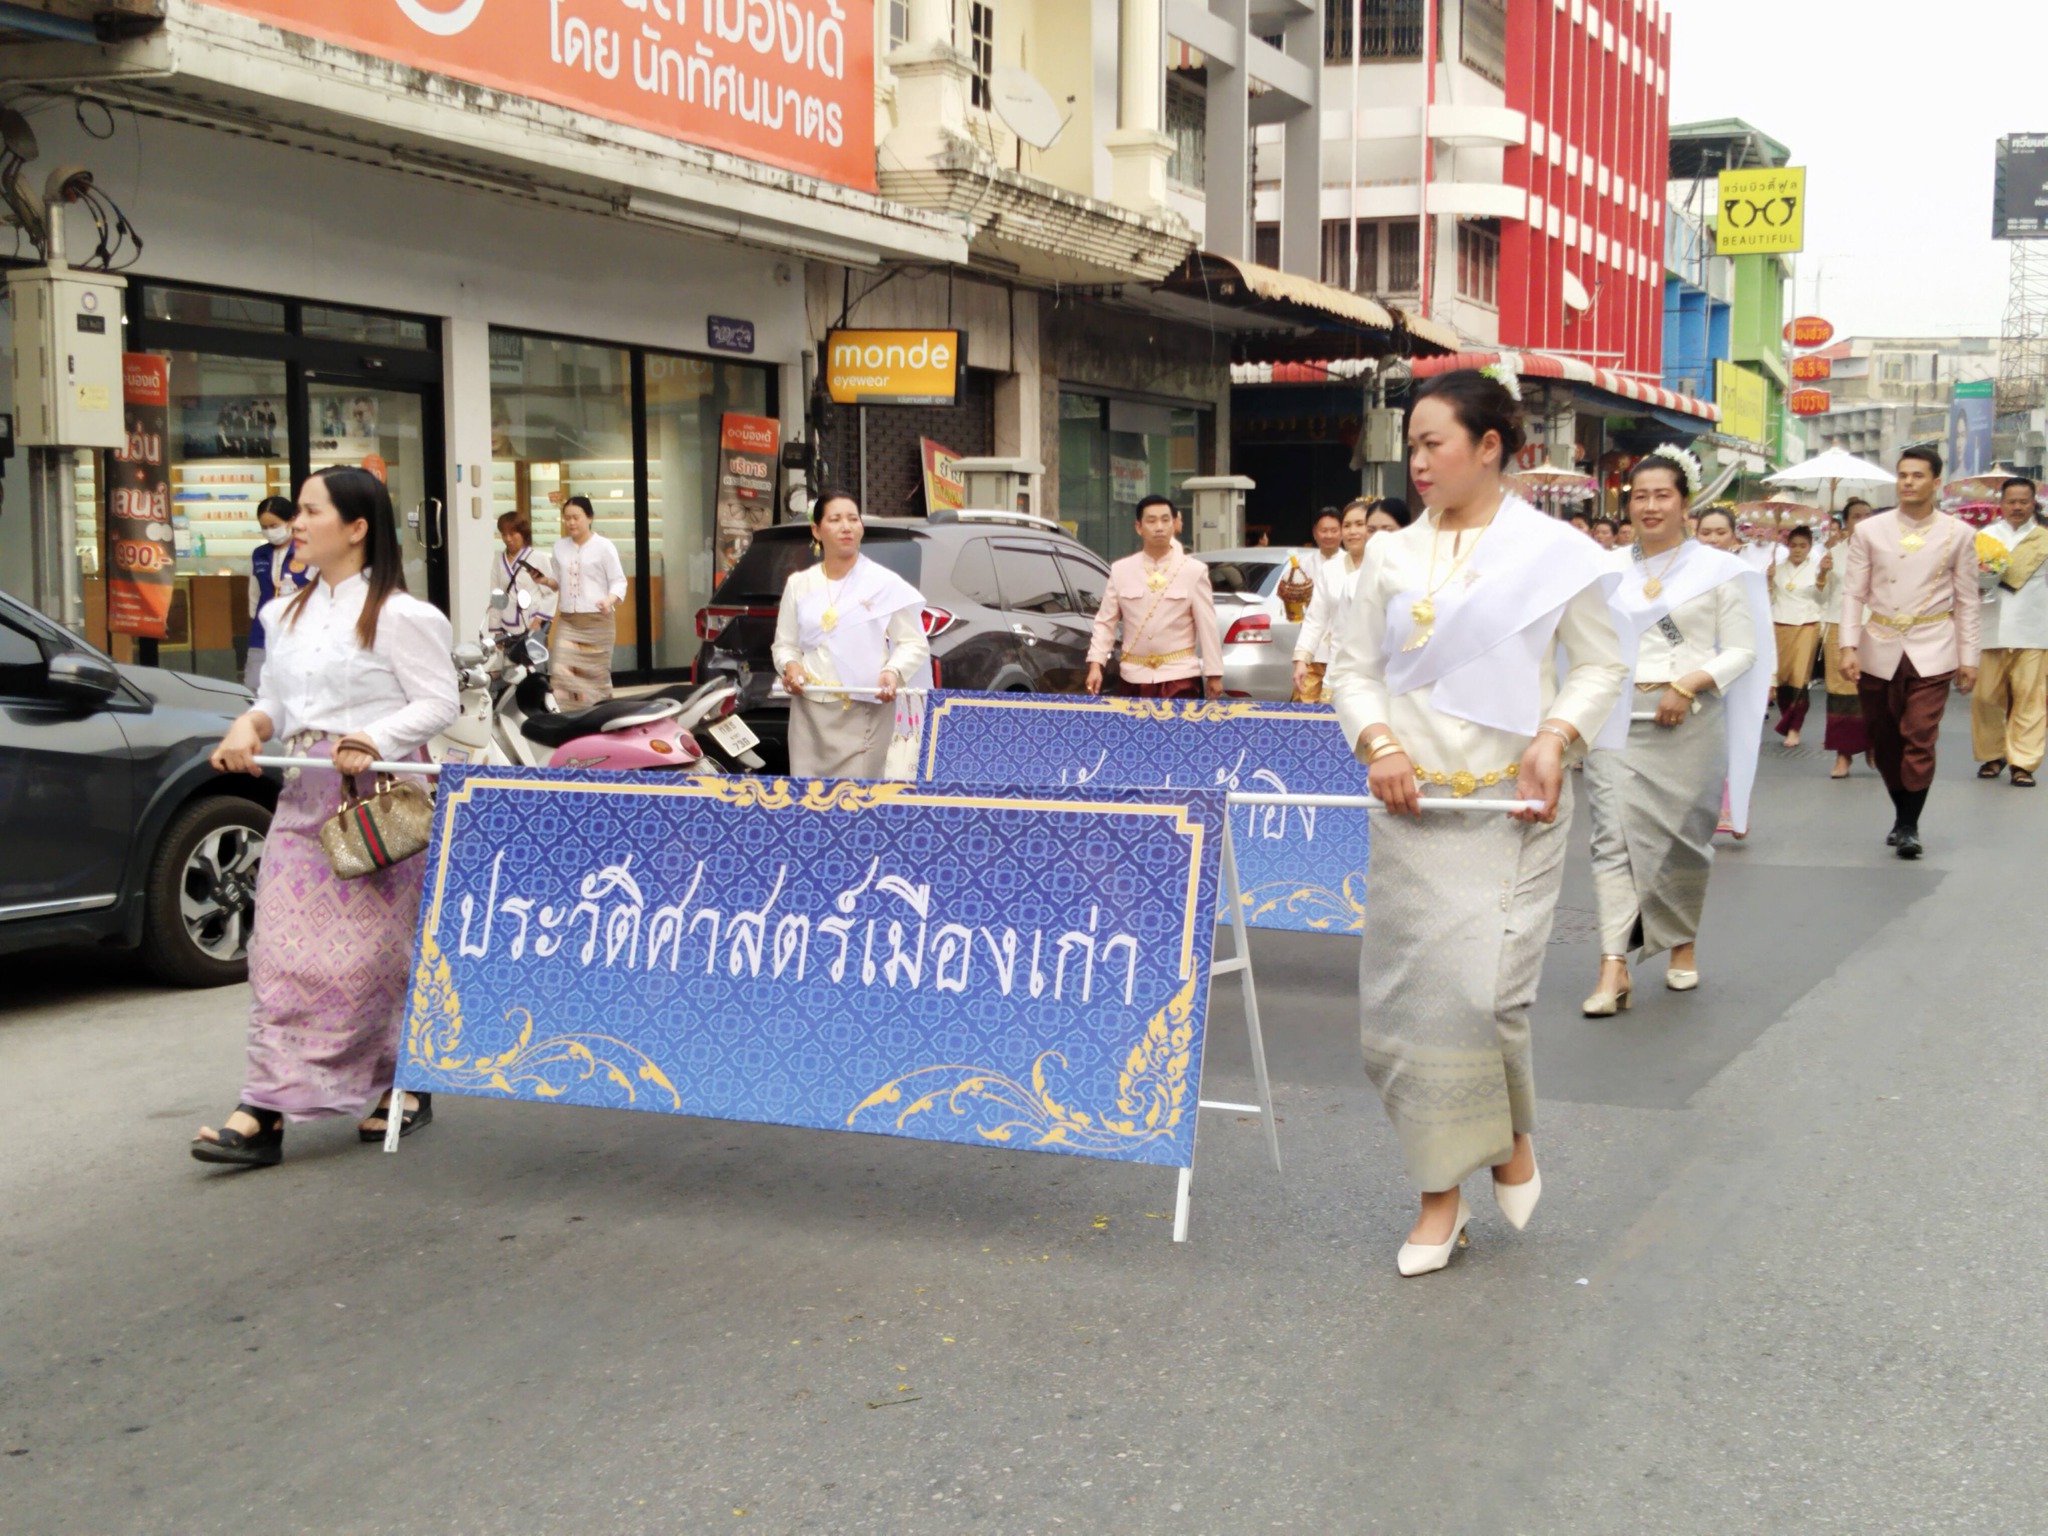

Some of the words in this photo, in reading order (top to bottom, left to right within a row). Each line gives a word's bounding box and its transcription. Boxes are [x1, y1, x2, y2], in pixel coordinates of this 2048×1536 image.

[550, 0, 620, 79] โดย
[633, 23, 843, 147] นักทัศนมาตร
[1722, 234, 1795, 246] BEAUTIFUL
[833, 337, 949, 369] monde
[833, 375, 890, 389] eyewear
[729, 456, 768, 479] บริการ
[460, 850, 1140, 1006] ประวัติศาสตร์เมืองเก่า
